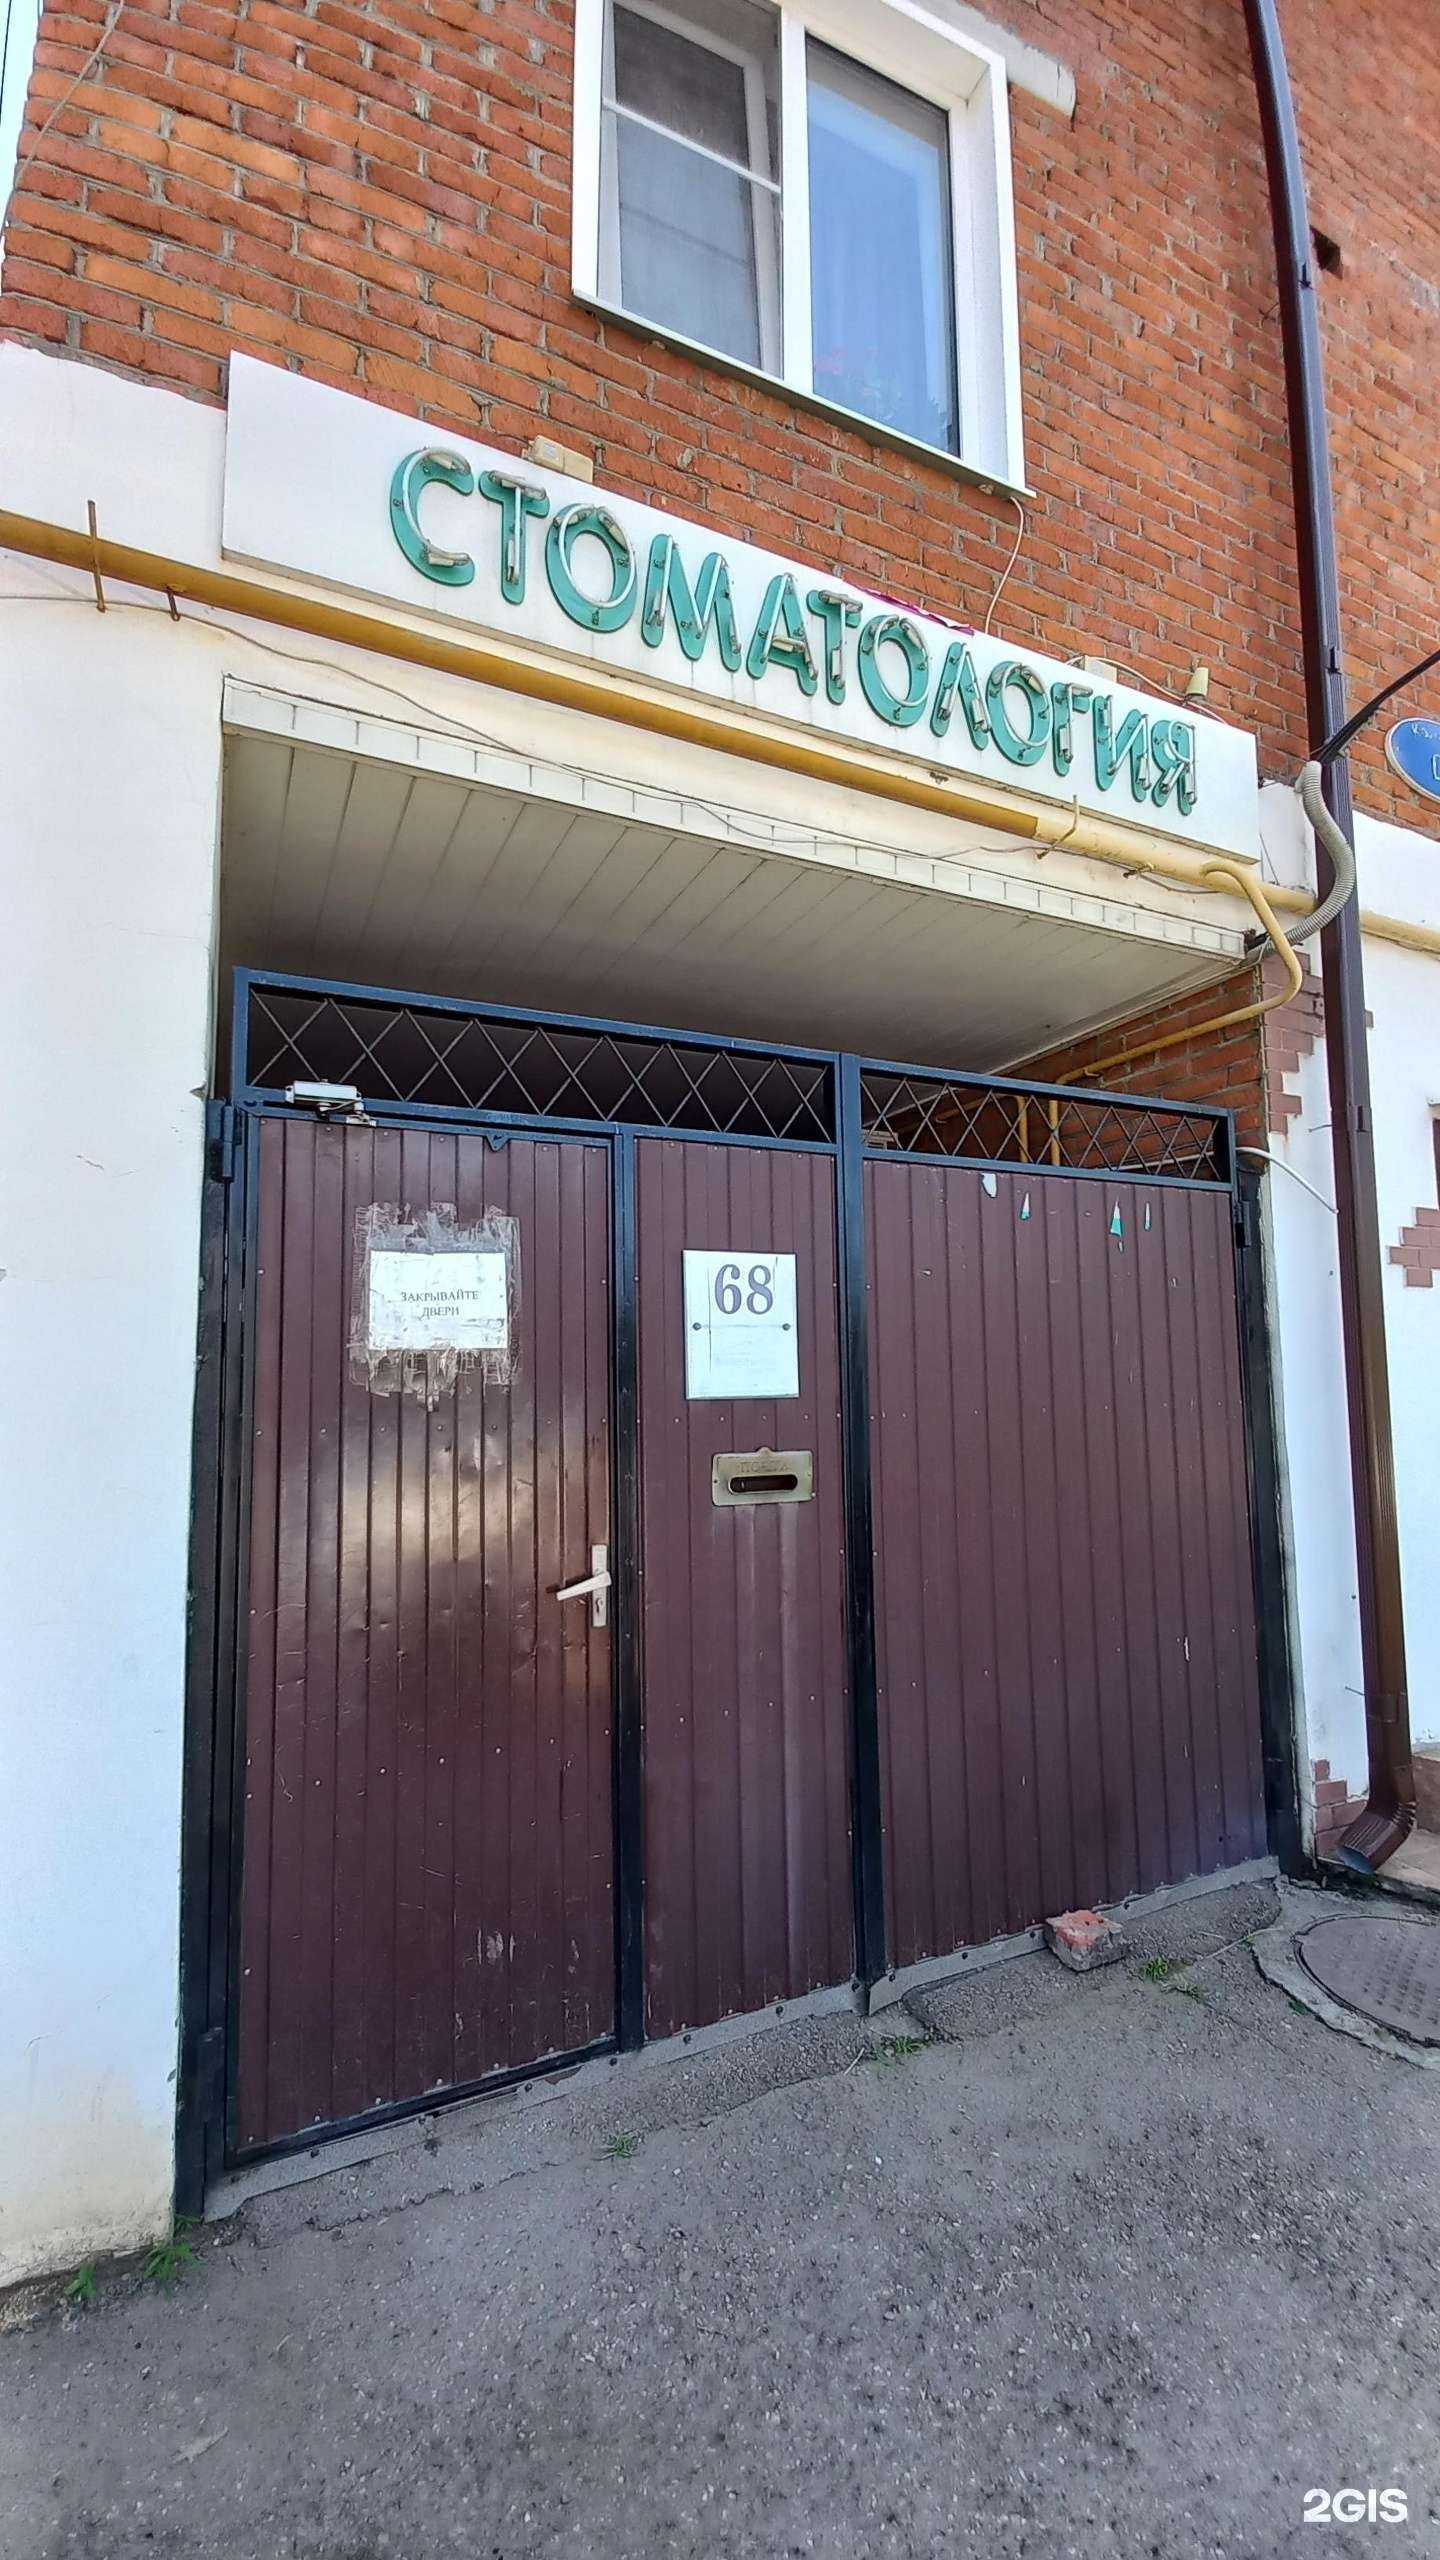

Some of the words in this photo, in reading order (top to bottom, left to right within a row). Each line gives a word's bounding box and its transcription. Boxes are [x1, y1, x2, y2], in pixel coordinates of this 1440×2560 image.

[390, 447, 1197, 816] СТОМАТОЛОГИЯ
[400, 1288, 480, 1302] ЗАКРЫВАЙТЕ
[714, 1263, 774, 1315] 68
[421, 1306, 460, 1320] ДВЕРИ
